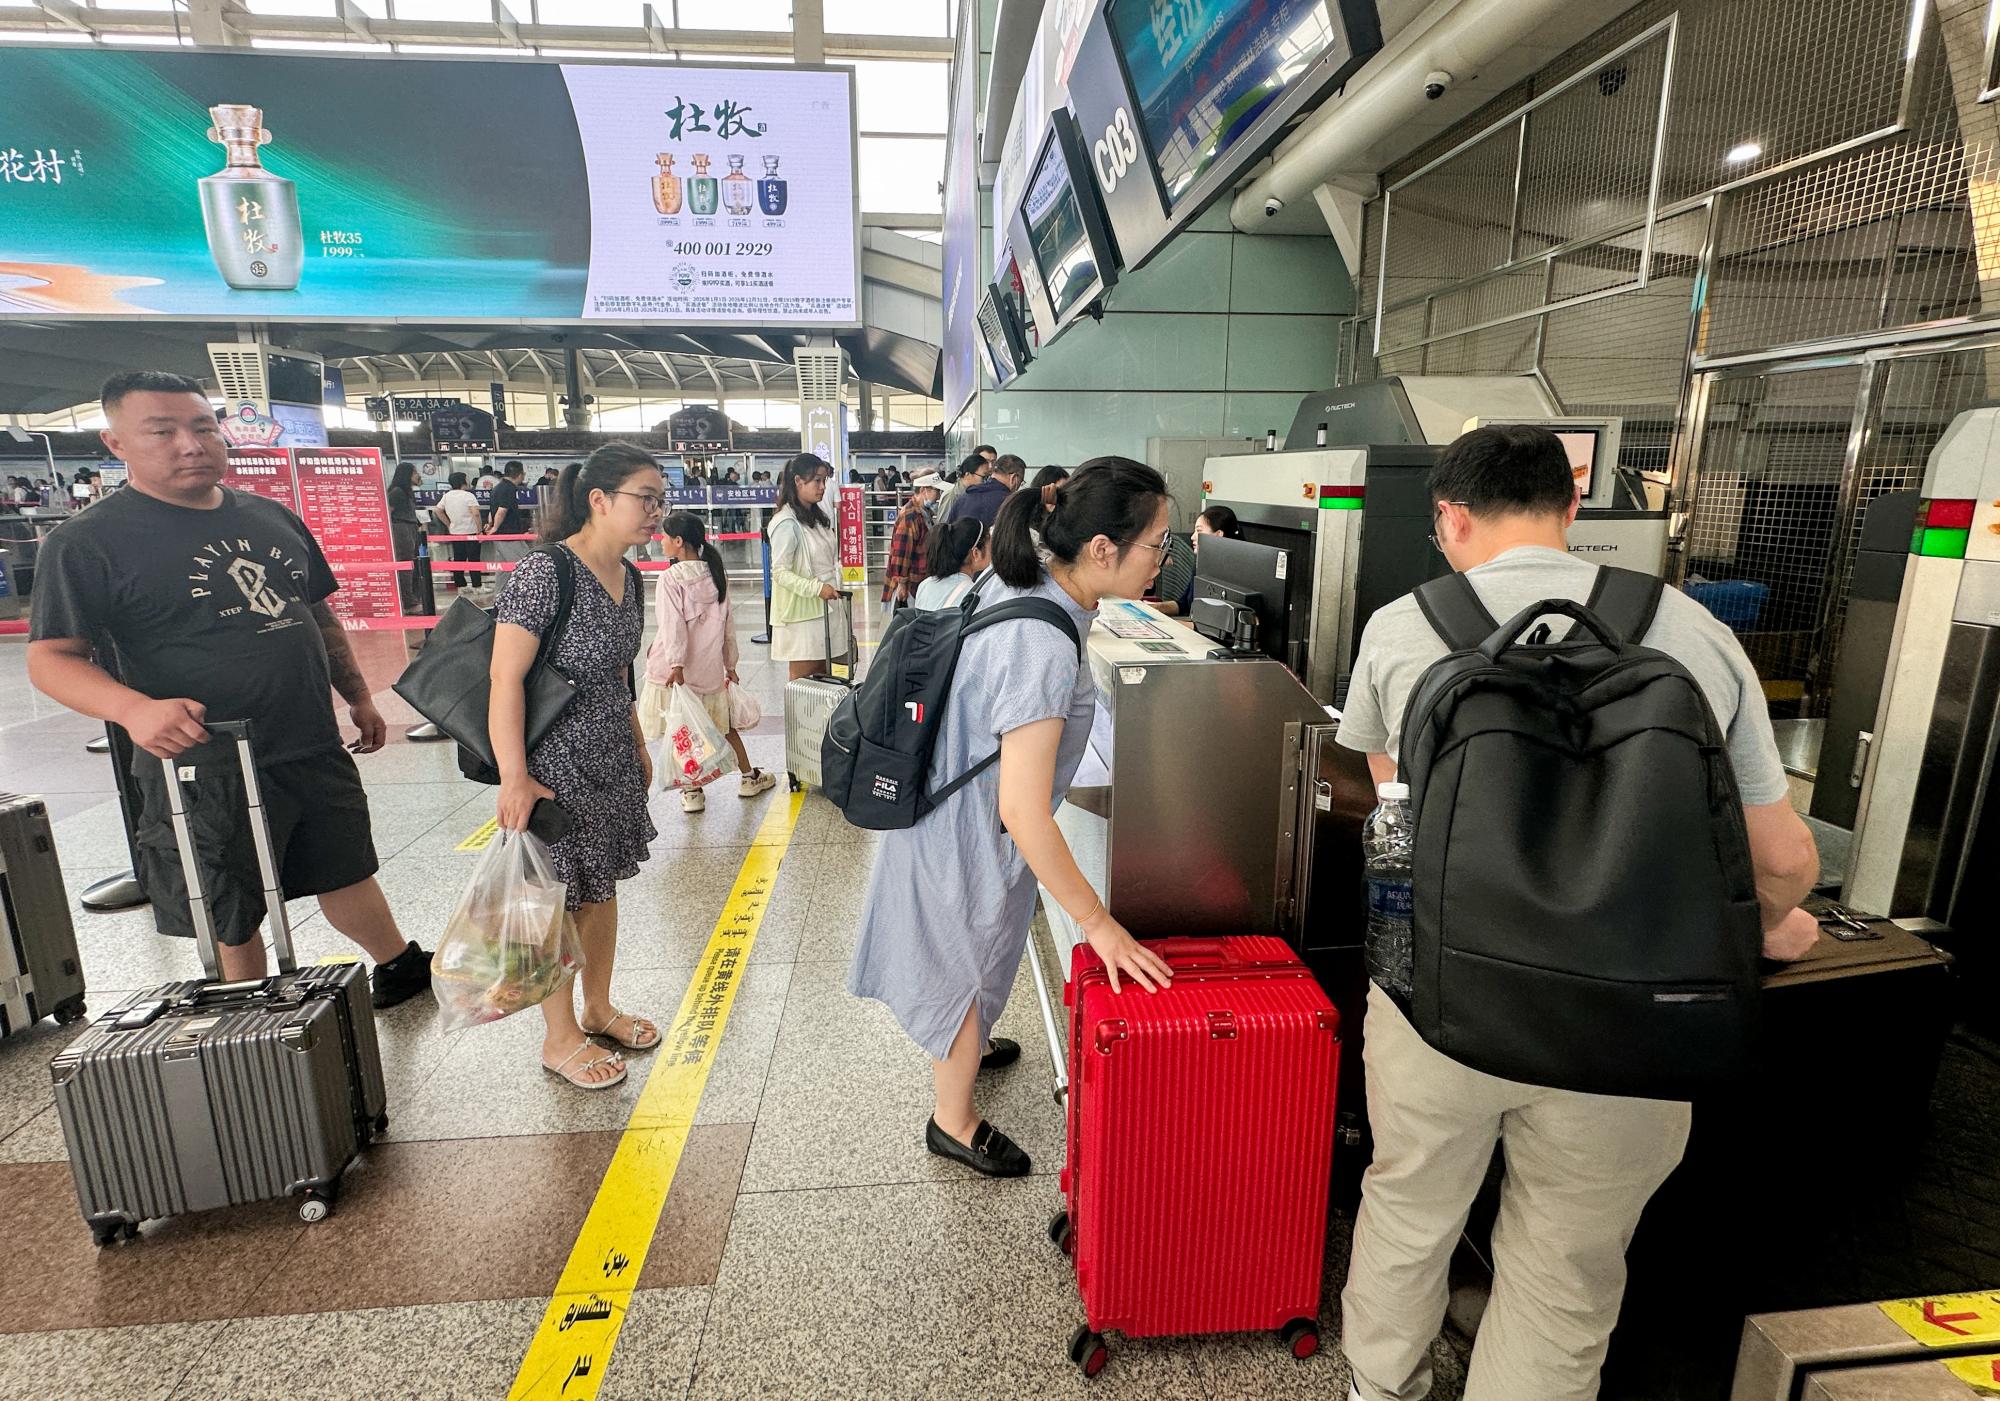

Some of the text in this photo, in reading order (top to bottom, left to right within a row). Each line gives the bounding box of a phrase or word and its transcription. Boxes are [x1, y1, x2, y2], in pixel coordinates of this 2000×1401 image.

[1207, 11, 1225, 40] CLASS
[665, 96, 762, 141] 杜牧
[1094, 107, 1137, 194] C03
[0, 148, 65, 184] 花村
[235, 196, 276, 254] 杜牧
[320, 230, 363, 244] 杜牧35
[674, 242, 700, 255] 400
[705, 243, 731, 256] 001
[736, 243, 773, 256] 2929
[727, 490, 757, 498] 安检区域
[847, 491, 858, 564] 非入口 请勿通行
[188, 539, 305, 598] PLAYIN BIG
[486, 562, 503, 571] IMA
[219, 606, 243, 617] XTEP
[341, 619, 369, 631] IMA
[875, 780, 897, 793] FILA
[710, 948, 724, 965] Please
[682, 947, 741, 1065] 请在黄线外排队等候
[689, 993, 703, 1015] behind
[667, 1051, 682, 1067] line
